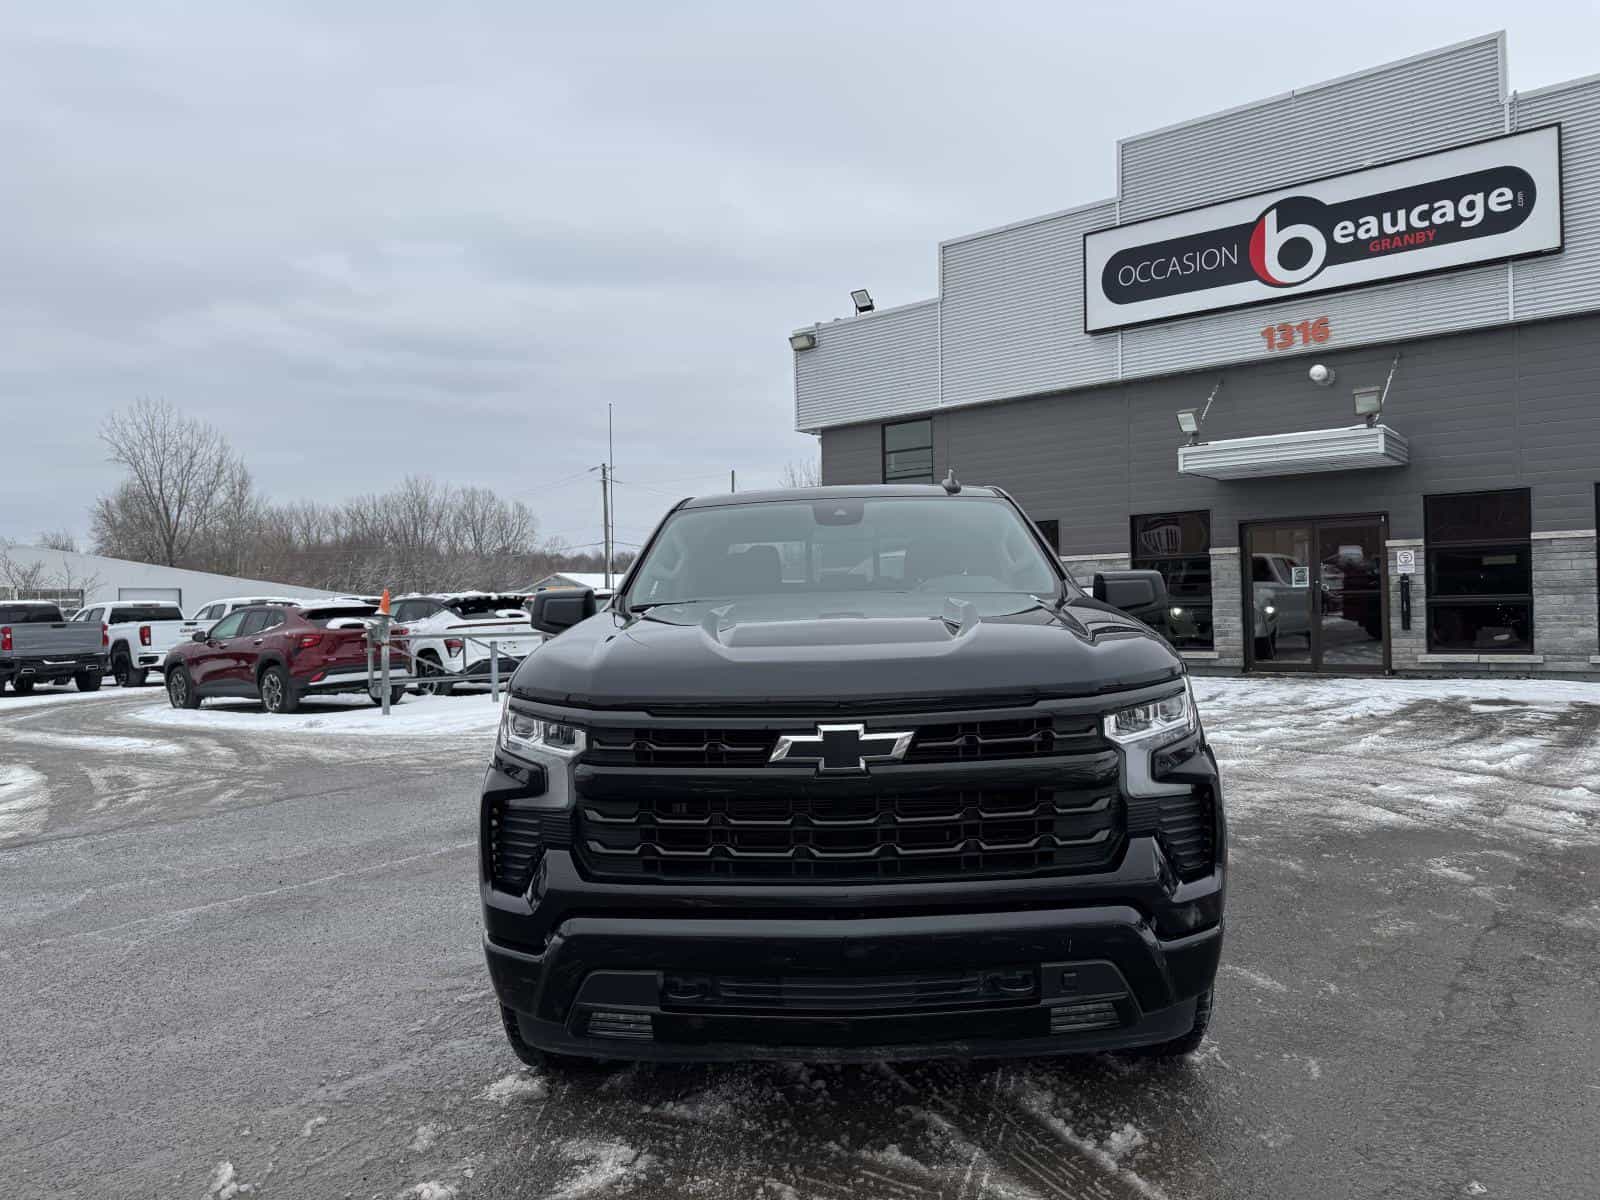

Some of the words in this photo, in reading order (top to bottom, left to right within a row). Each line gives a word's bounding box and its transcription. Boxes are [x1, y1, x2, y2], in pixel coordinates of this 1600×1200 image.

[1369, 229, 1437, 252] GRANBY
[1118, 243, 1239, 286] OCCASION
[1260, 315, 1330, 352] 1316
